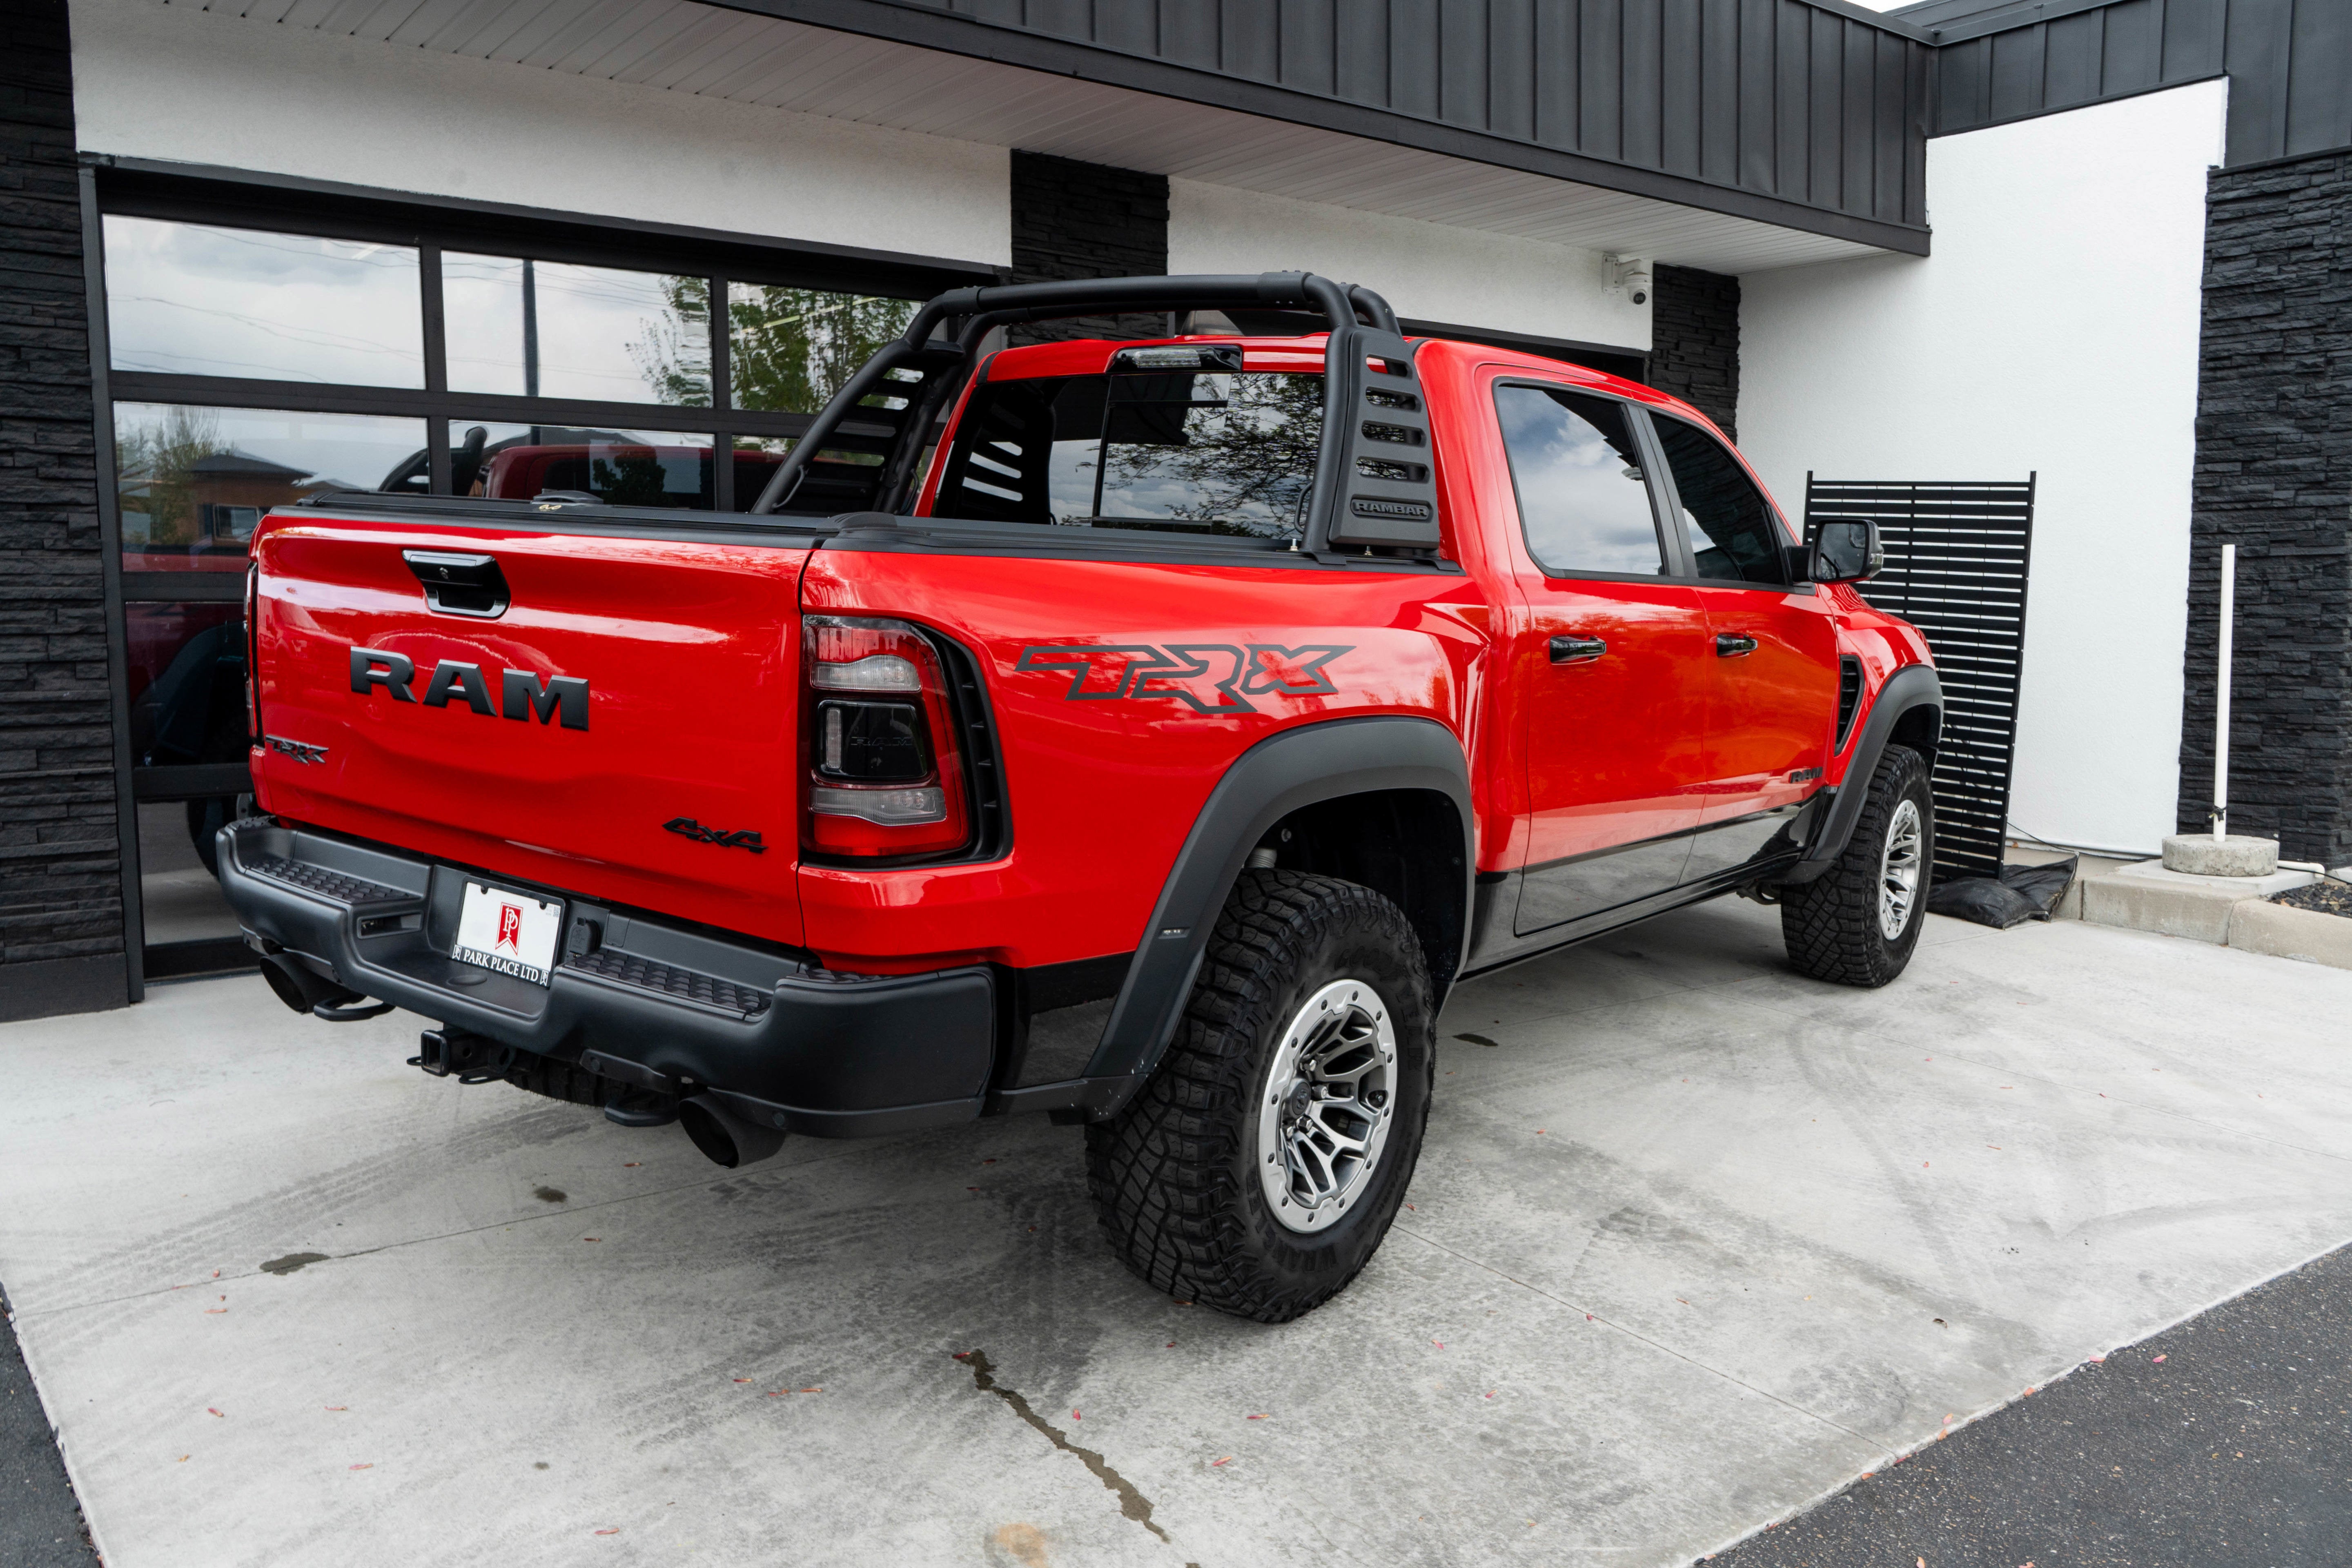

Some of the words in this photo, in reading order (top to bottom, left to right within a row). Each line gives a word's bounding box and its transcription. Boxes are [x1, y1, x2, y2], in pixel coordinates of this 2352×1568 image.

[1354, 502, 1428, 517] RAMBAR
[350, 646, 589, 732] RAM
[1014, 644, 1357, 714] TRX
[265, 734, 329, 764] TRX
[851, 737, 914, 746] RAM
[1790, 766, 1823, 784] RAM
[463, 949, 490, 967] PARK
[490, 956, 520, 976] PLACE
[520, 965, 539, 982] LTD
